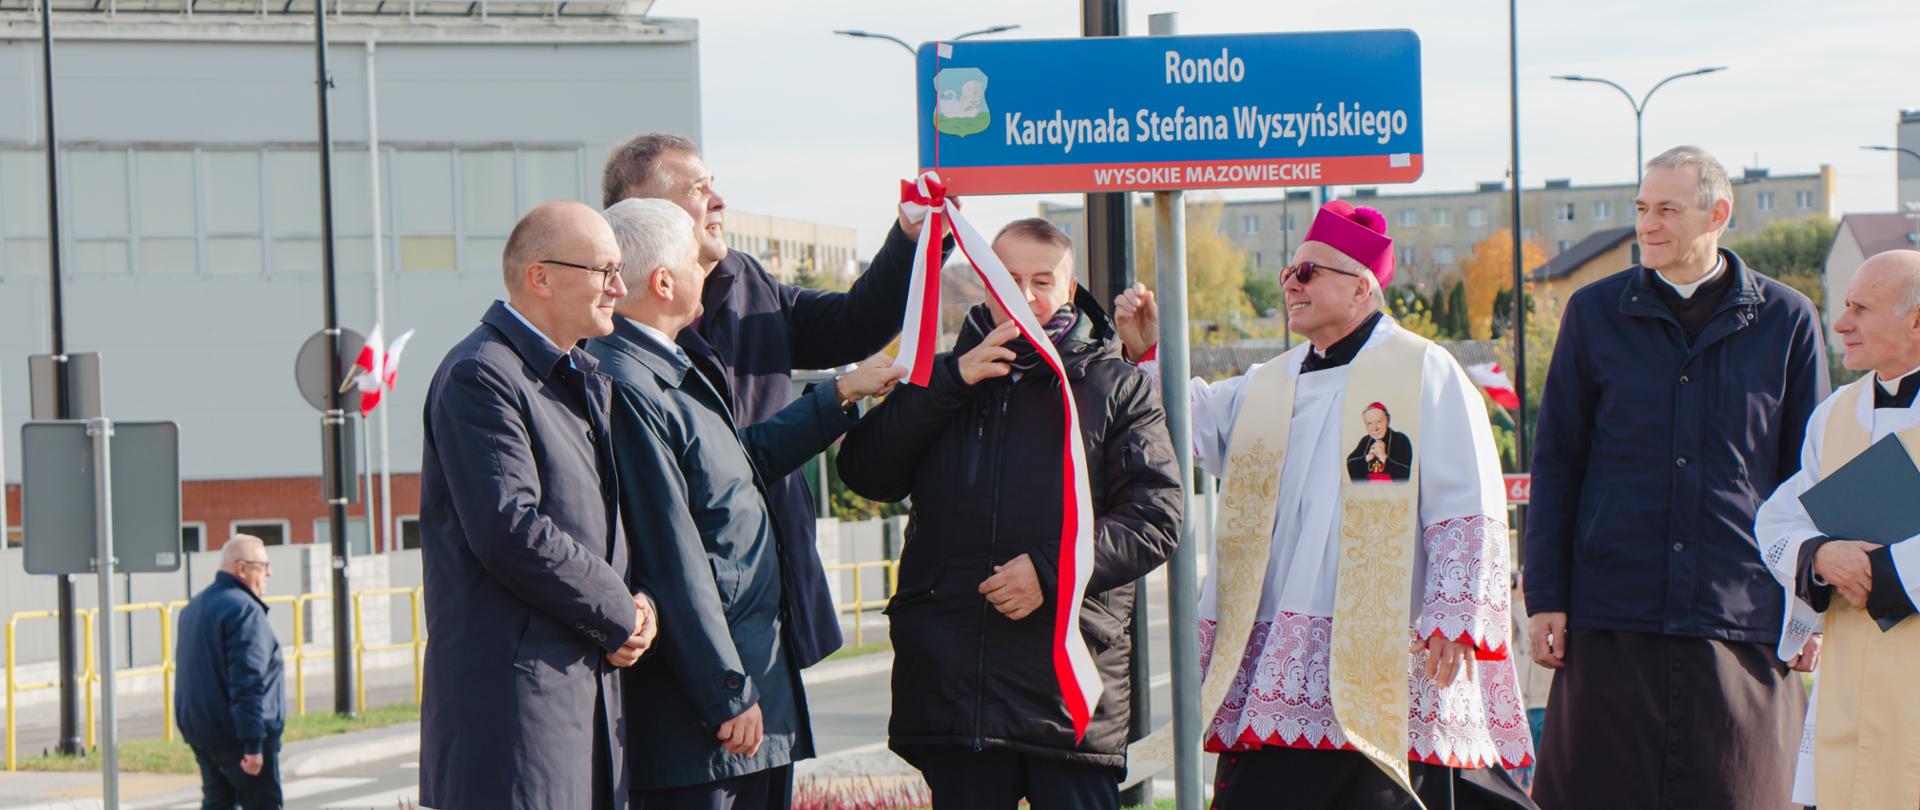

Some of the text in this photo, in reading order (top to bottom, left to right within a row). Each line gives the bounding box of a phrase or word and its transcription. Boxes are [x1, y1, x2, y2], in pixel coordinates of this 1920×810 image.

[1165, 47, 1246, 84] Rondo
[1005, 102, 1408, 152] Kardynała Stefana Wyszyńskiego
[1094, 162, 1322, 186] WYSOKIE MAZOWIECKIE
